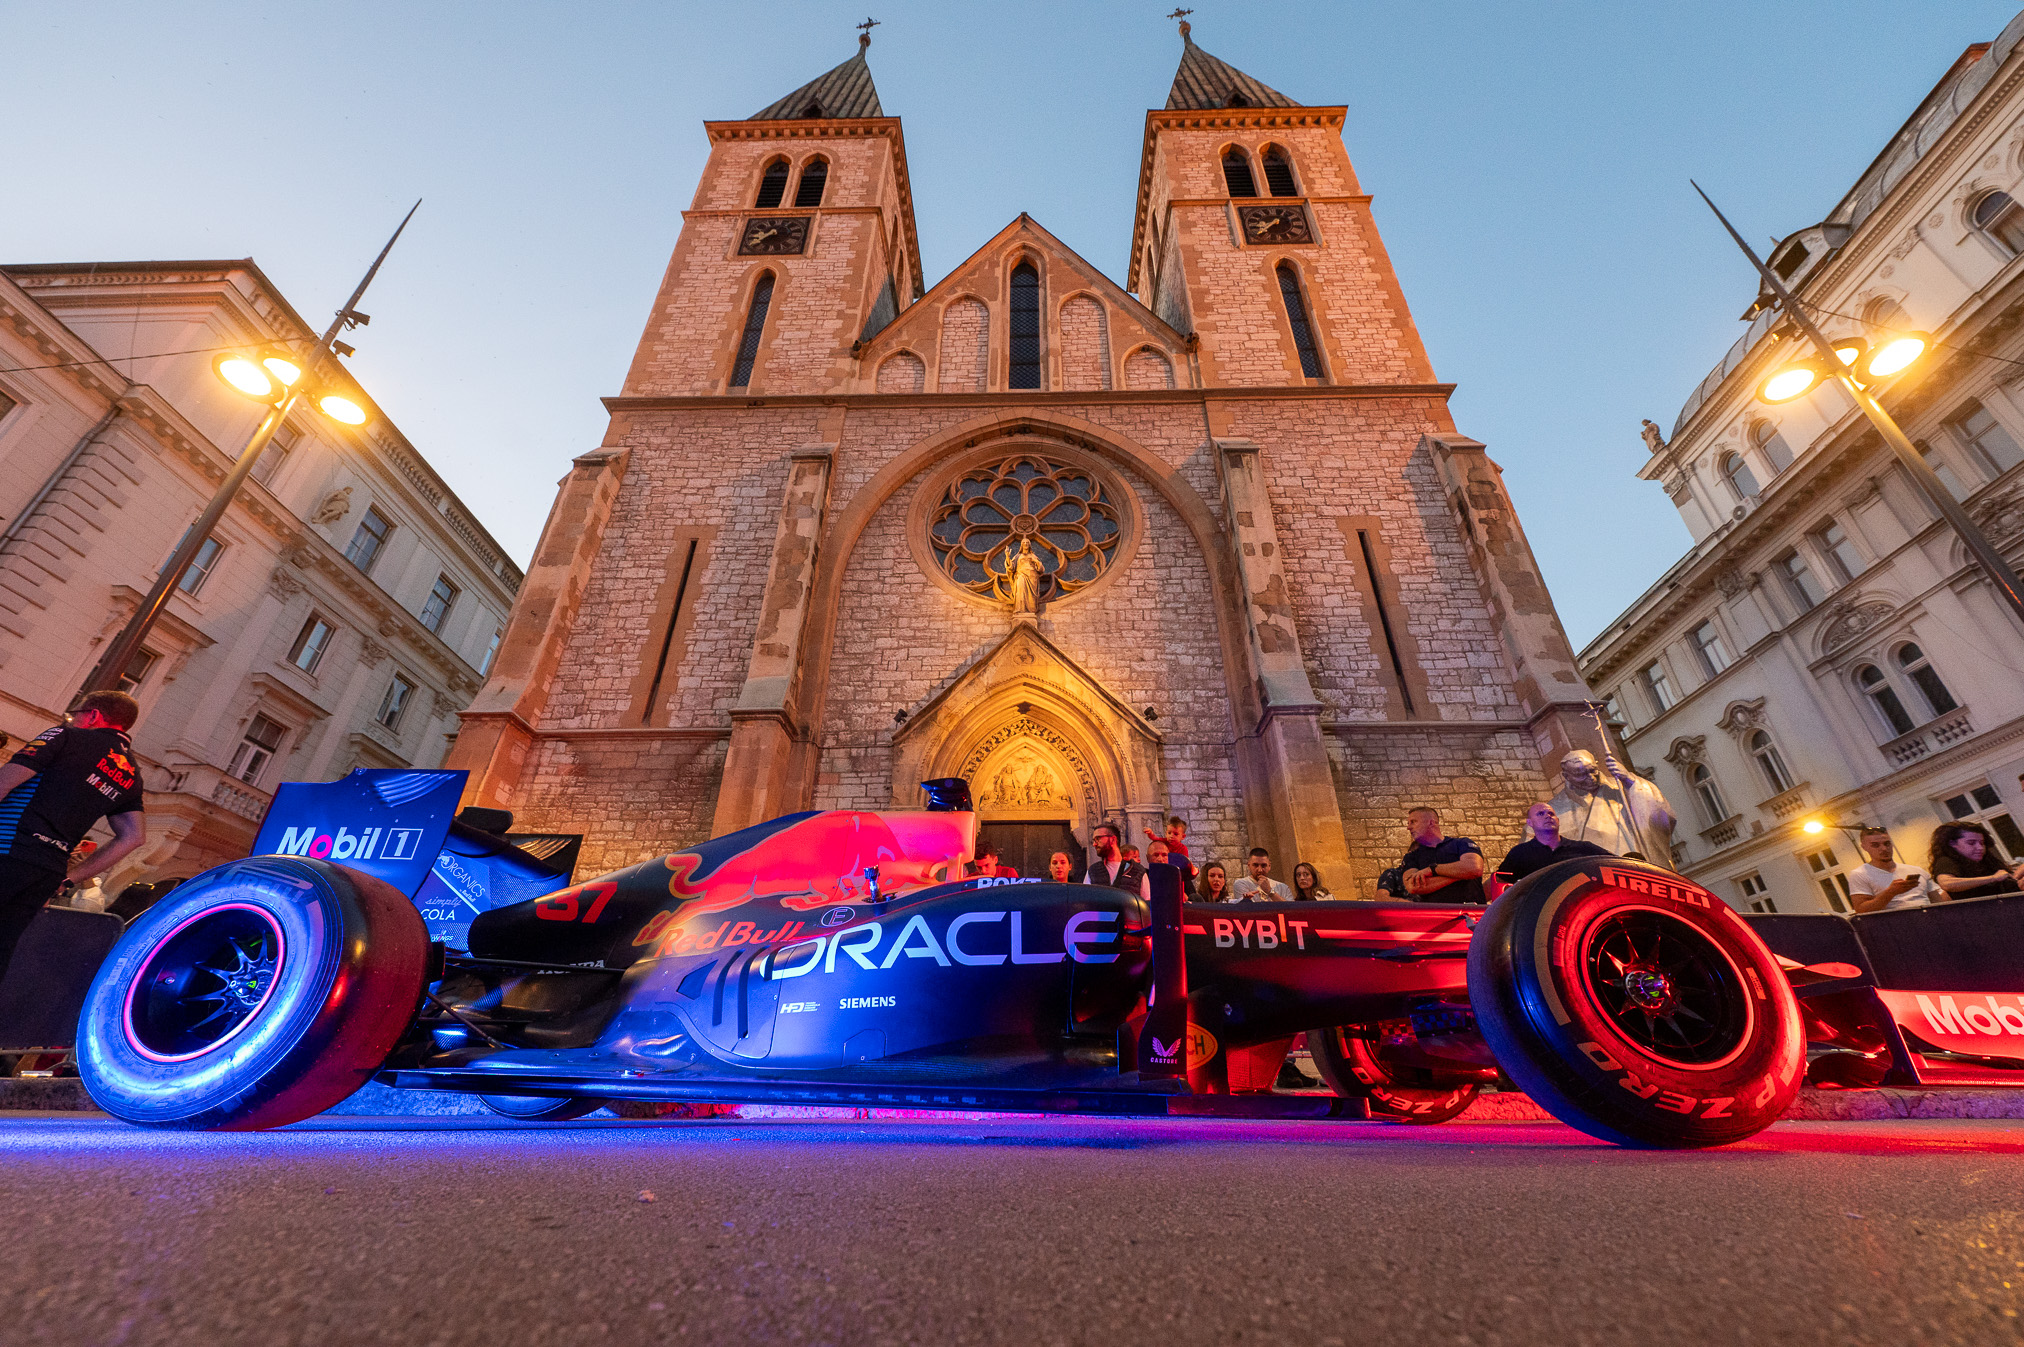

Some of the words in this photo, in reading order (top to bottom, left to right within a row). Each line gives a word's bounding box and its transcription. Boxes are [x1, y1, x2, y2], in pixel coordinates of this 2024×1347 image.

[86, 773, 113, 797] Mobil
[96, 758, 118, 778] Red
[112, 770, 134, 790] Bull
[276, 827, 382, 859] Mobil
[393, 831, 410, 857] 1
[440, 856, 486, 897] ORGANICS
[1599, 866, 1711, 909] PIRELLI
[421, 909, 455, 920] COLA
[425, 896, 462, 907] simply
[534, 882, 618, 924] 37
[653, 921, 731, 958] Red
[721, 921, 805, 948] Bull
[759, 911, 1121, 980] ORACLE
[1213, 913, 1309, 950] BYBIT
[839, 996, 896, 1009] SIEMENS
[1915, 994, 2024, 1036] Mob
[1351, 1067, 1435, 1114] ZERO
[1577, 1041, 1735, 1119] ZERO
[1755, 1072, 1776, 1109] P
